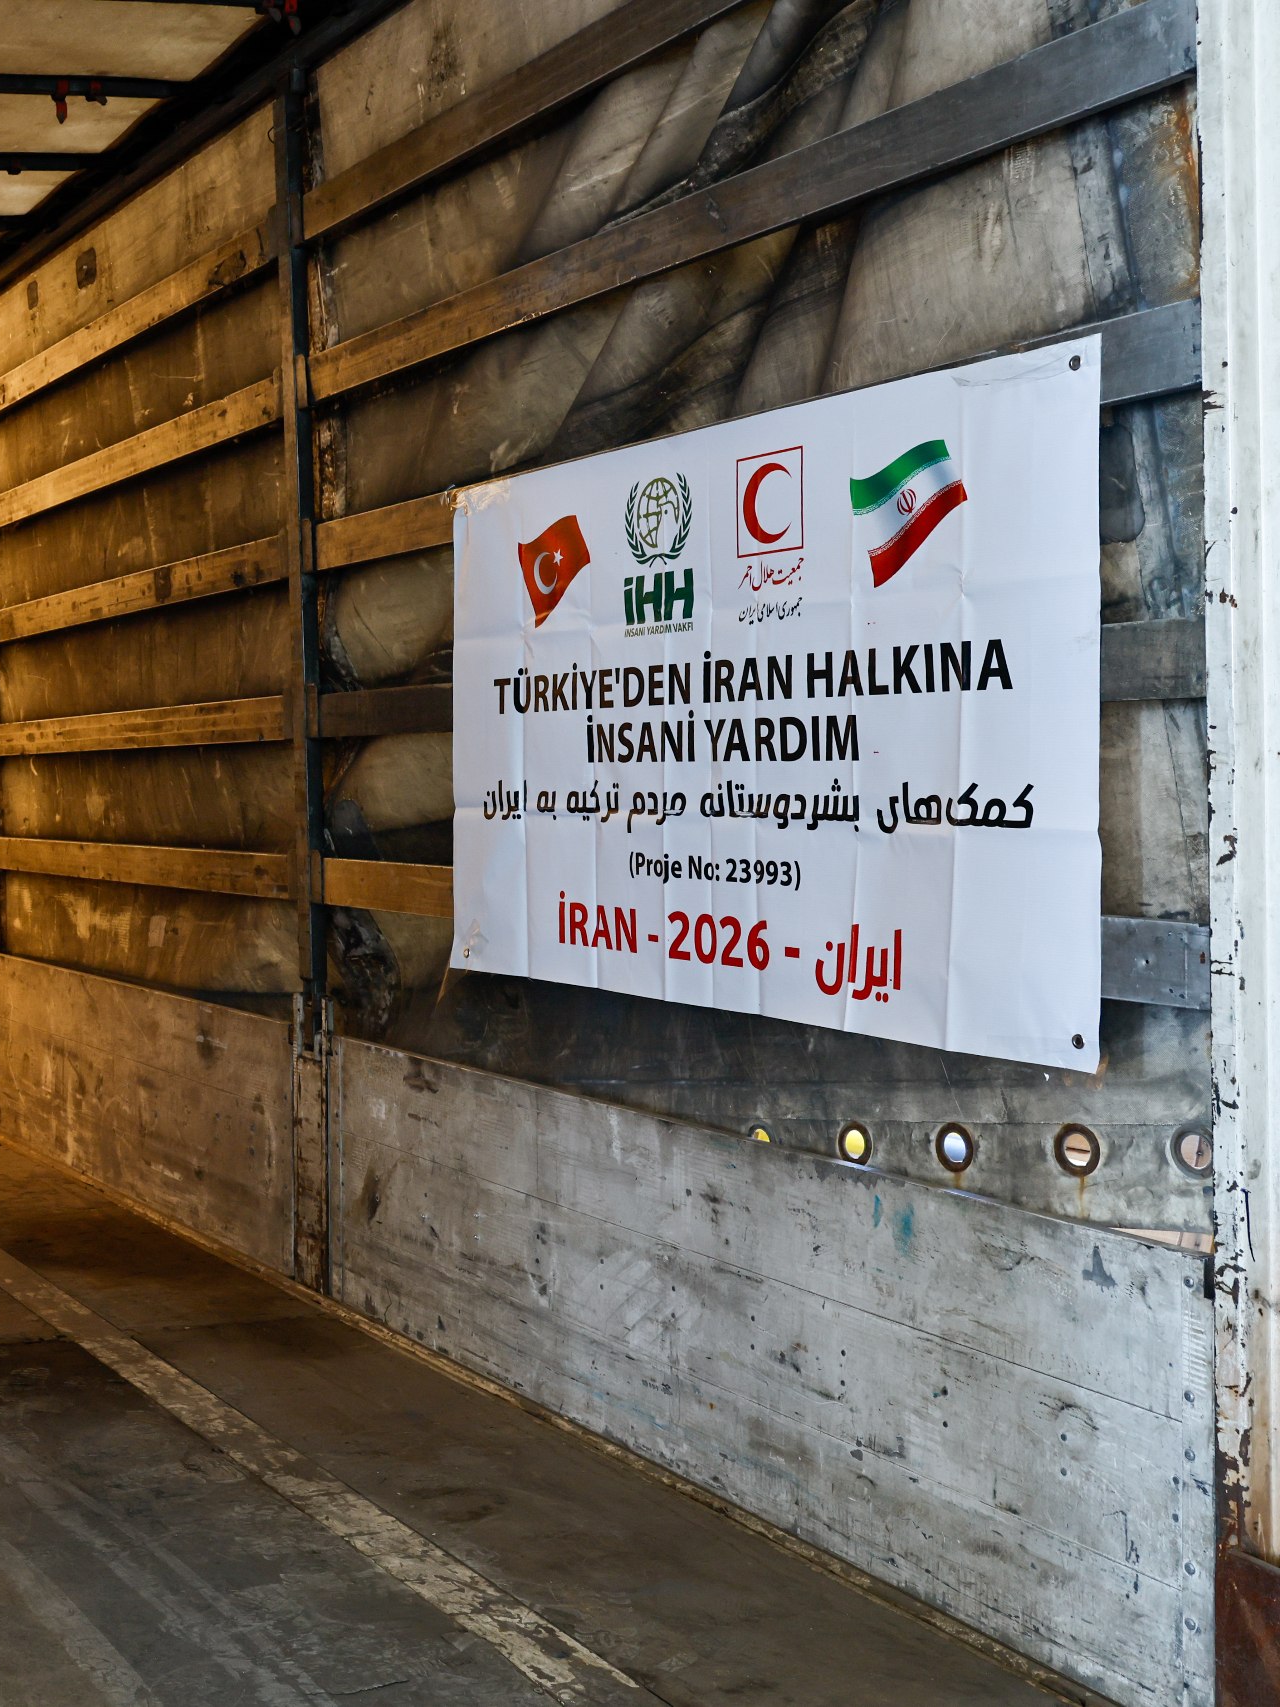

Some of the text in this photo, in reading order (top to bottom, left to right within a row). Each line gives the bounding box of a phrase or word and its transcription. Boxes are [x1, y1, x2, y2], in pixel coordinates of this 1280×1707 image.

[737, 557, 805, 592] جمعیت هلال احمر
[646, 623, 673, 636] YARDIM
[672, 621, 694, 633] VAKFI
[738, 596, 803, 626] جمهوری اسلامی ایران
[493, 638, 1014, 715] TÜRKİYE'DEN İRAN HALKINA
[586, 709, 860, 764] İNSANİ YARDIM
[483, 779, 528, 821] ایران
[536, 790, 558, 821] به
[566, 779, 620, 824] ترکیه
[626, 790, 687, 834] مردم
[699, 777, 860, 833] بشردوستانه
[629, 851, 802, 892] (Proje No: 23993)
[558, 890, 638, 954] İRAN
[667, 910, 770, 972] 2026
[814, 923, 902, 1004] ایران
